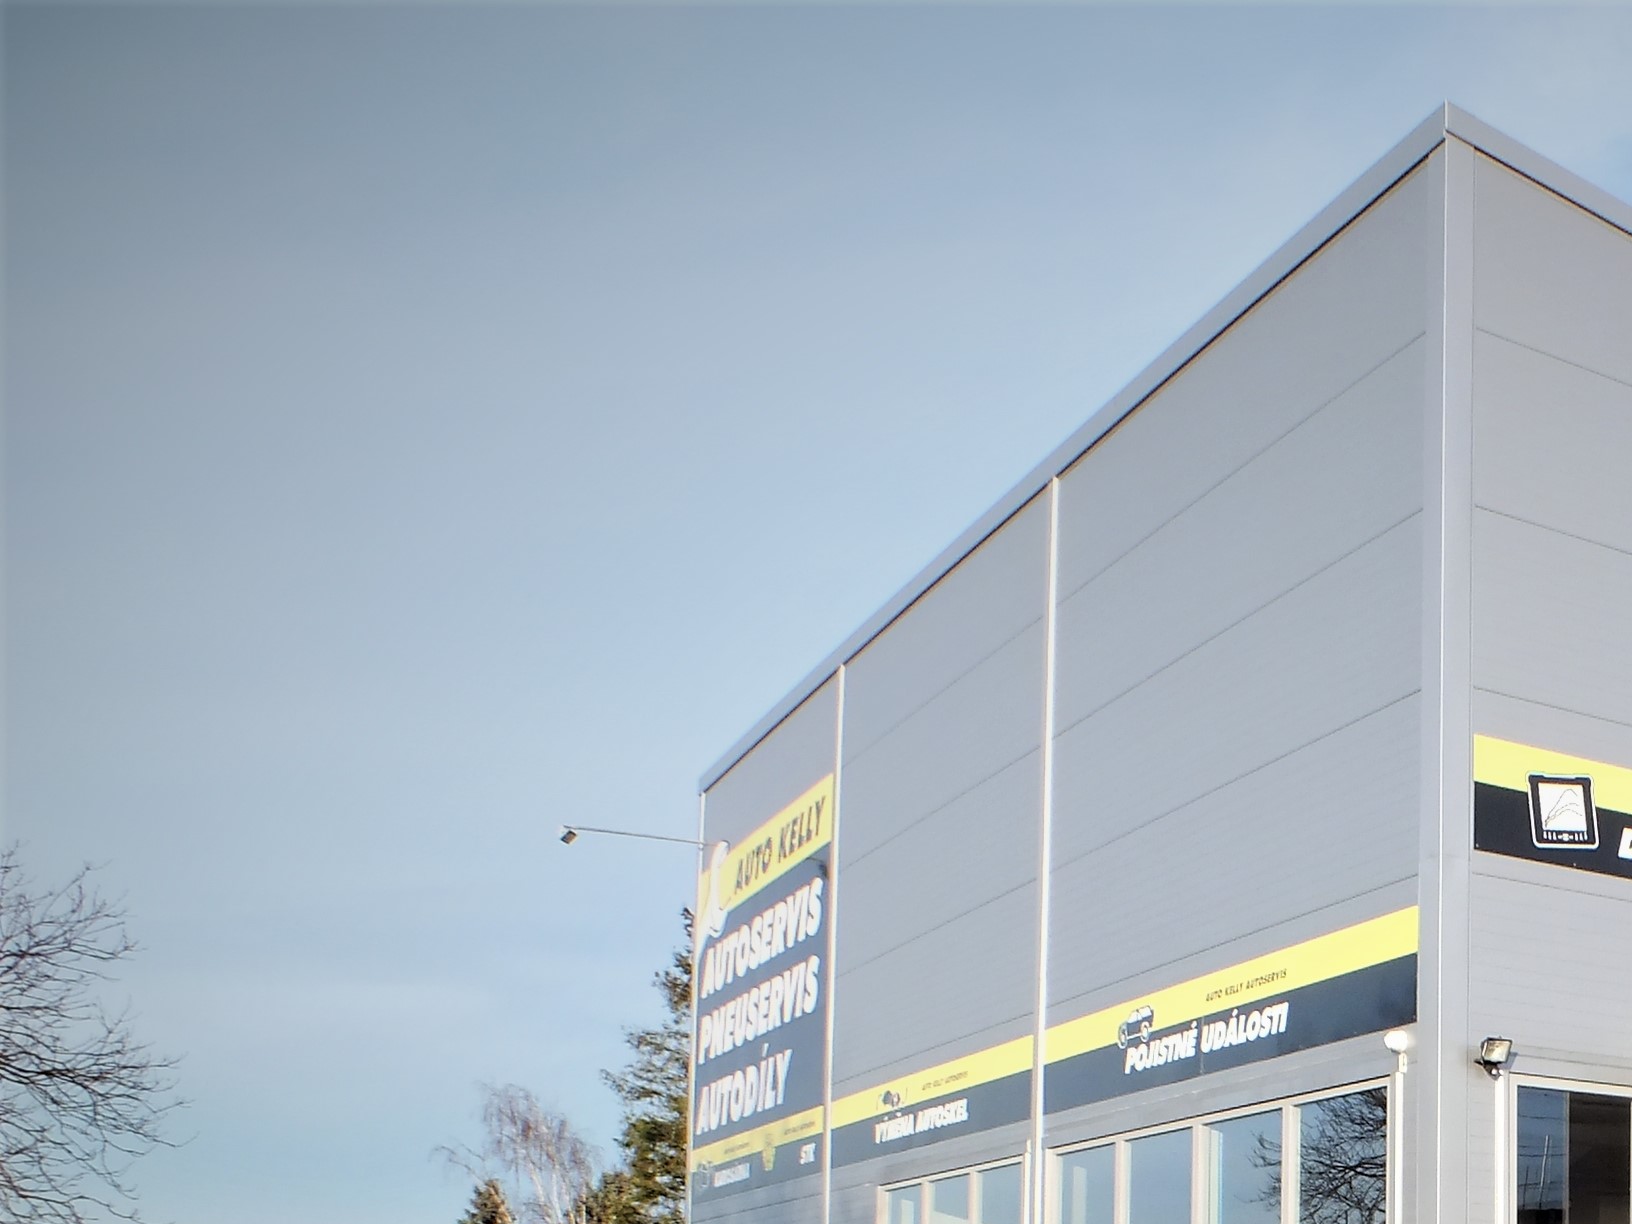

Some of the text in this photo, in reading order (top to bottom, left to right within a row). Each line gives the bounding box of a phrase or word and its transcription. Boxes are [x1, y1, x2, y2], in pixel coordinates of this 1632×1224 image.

[735, 795, 826, 895] AUTO KELLY
[701, 876, 822, 999] AUTOSERVIS
[1205, 968, 1287, 1002] AUTO KELLY AUTOSERVIS
[698, 954, 821, 1065] PNEUSERVIS
[1124, 1001, 1289, 1074] POJISTNÉ UDÁLOSTI
[695, 1043, 793, 1135] AUTODÍLY
